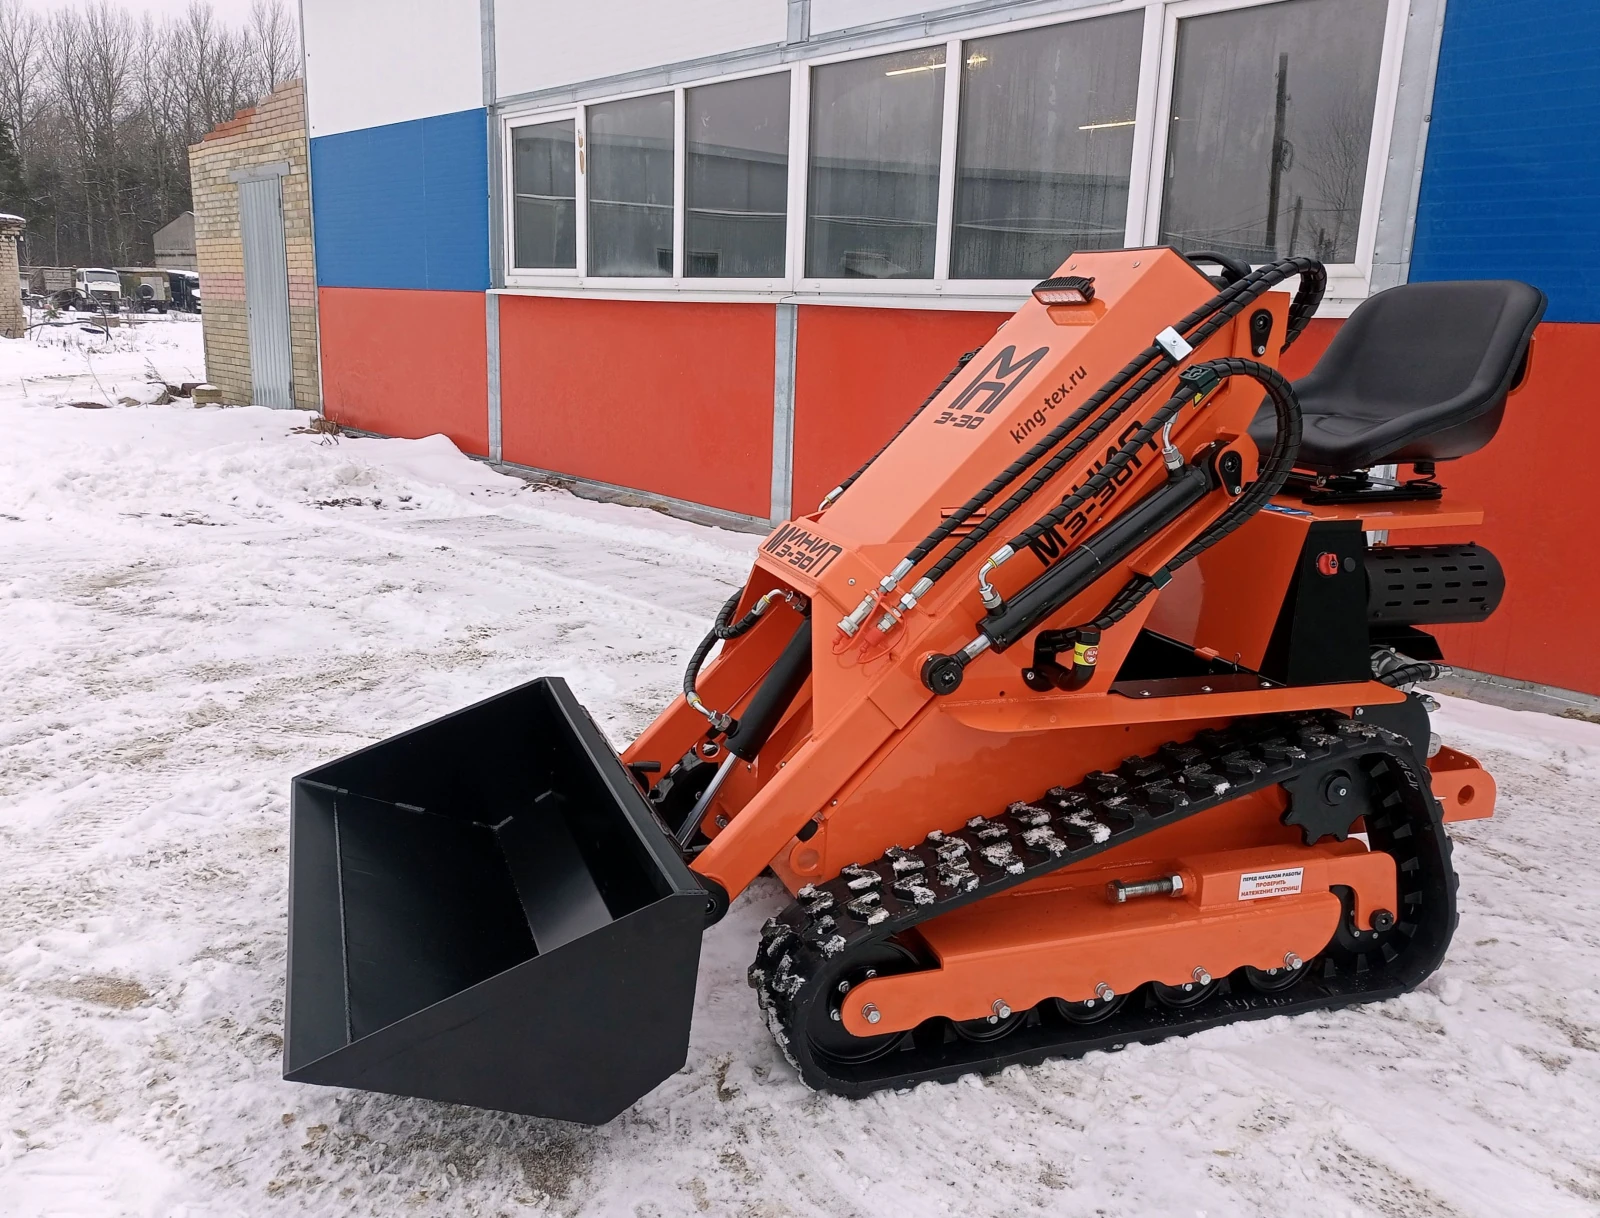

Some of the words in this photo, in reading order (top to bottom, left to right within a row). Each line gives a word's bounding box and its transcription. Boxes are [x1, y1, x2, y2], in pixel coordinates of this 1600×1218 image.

[1009, 365, 1088, 444] king-tex.ru
[1258, 873, 1282, 881] НАЧАЛОМ
[1255, 880, 1287, 888] ПРОВЕРИТЬ
[1240, 888, 1273, 896] НАТЯЖЕНИЕ
